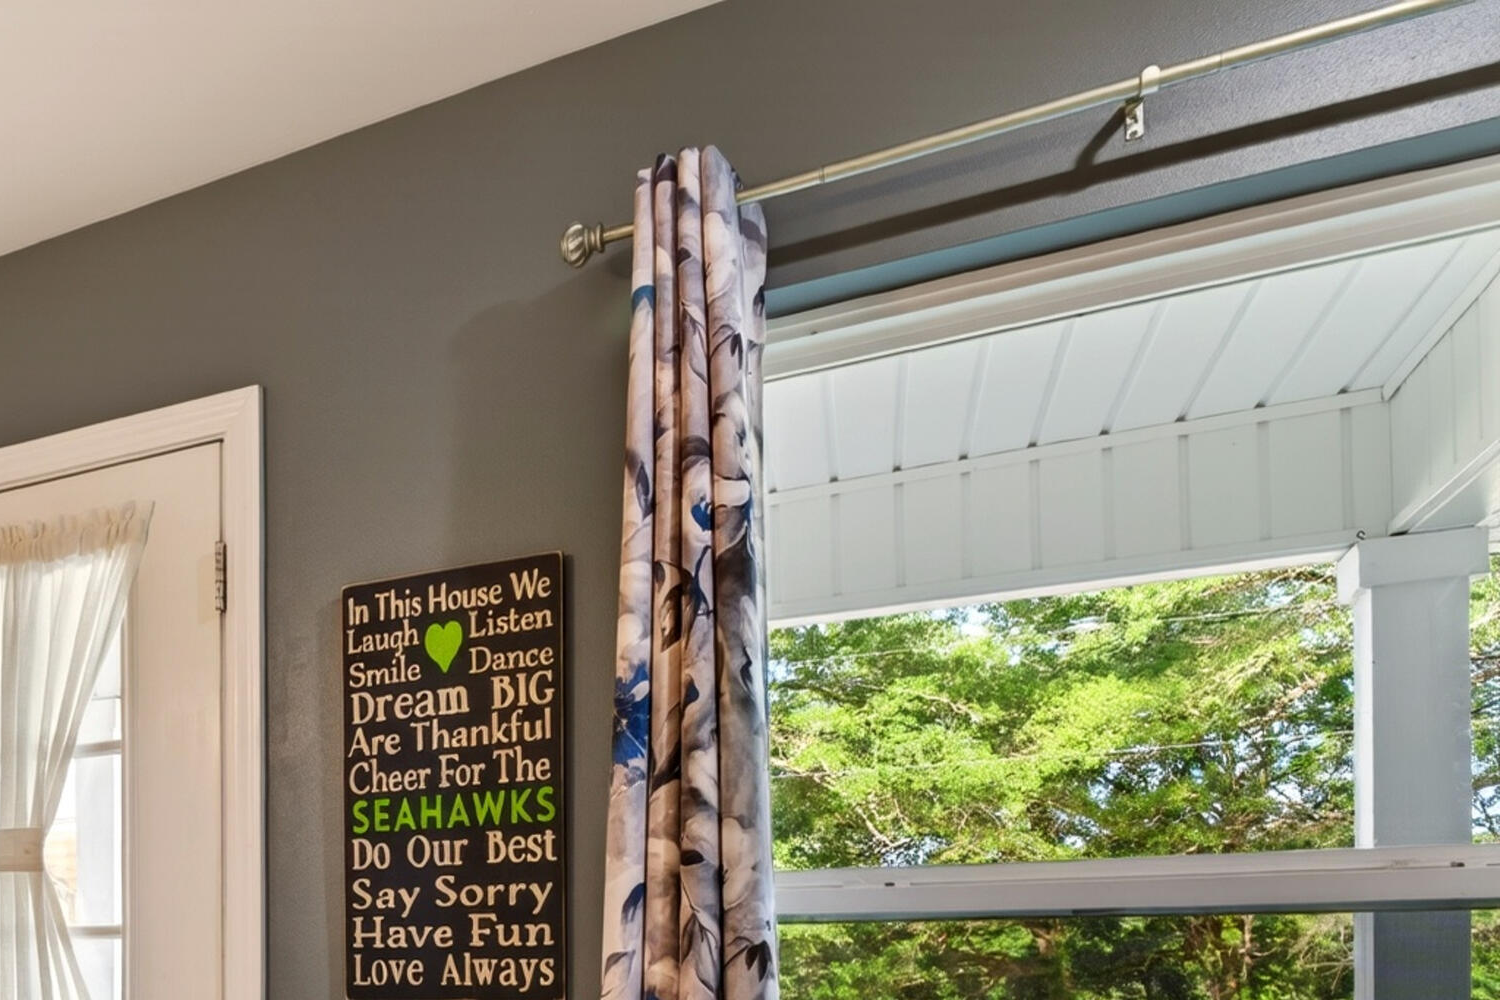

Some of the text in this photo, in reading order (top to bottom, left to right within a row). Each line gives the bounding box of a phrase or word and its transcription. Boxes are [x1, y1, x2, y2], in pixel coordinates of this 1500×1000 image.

[347, 568, 552, 625] In This House We
[347, 608, 553, 656] Laugh Listen
[349, 646, 554, 688] Smile Dance
[351, 670, 555, 725] Dream BIG
[348, 707, 551, 758] Are Thankful
[350, 746, 551, 795] Cheer For The
[352, 786, 556, 834] SEAHAWKS
[352, 829, 558, 870] Do Our Best
[352, 875, 553, 918] Say Sorry
[352, 913, 554, 948] Have Fun
[353, 952, 555, 992] Love Always
